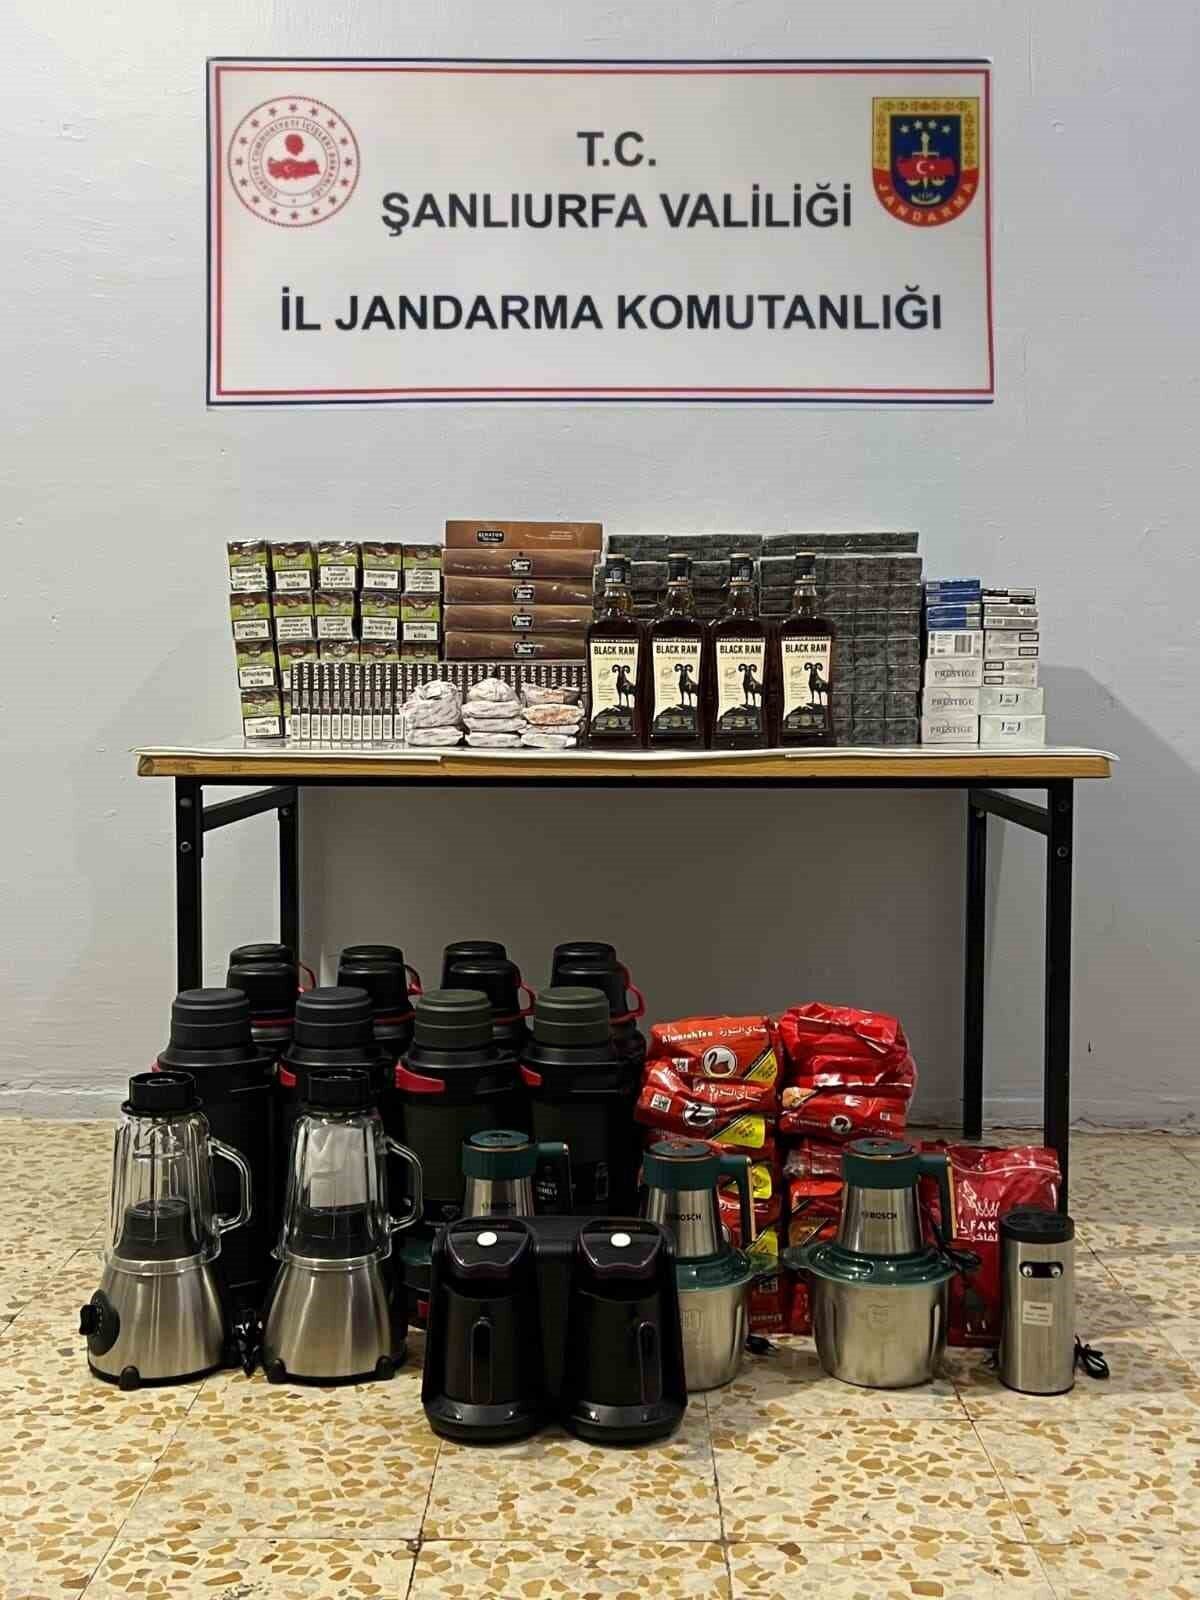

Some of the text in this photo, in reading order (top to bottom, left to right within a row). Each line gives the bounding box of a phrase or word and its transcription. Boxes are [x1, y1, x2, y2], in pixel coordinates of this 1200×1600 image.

[577, 131, 656, 167] T.C.
[878, 181, 973, 222] JANDARMA
[382, 183, 851, 237] ŞANLIURFA VALİLİĞİ
[281, 284, 941, 331] İL JANDARMA KOMUTANLIĞI
[593, 645, 635, 656] BLACK RAM
[656, 644, 698, 655] BLACK RAM
[719, 644, 762, 655] BLACK RAM
[785, 643, 827, 653] BLACK RAM
[870, 1211, 897, 1220] BOSCH
[970, 1219, 997, 1232] FAK
